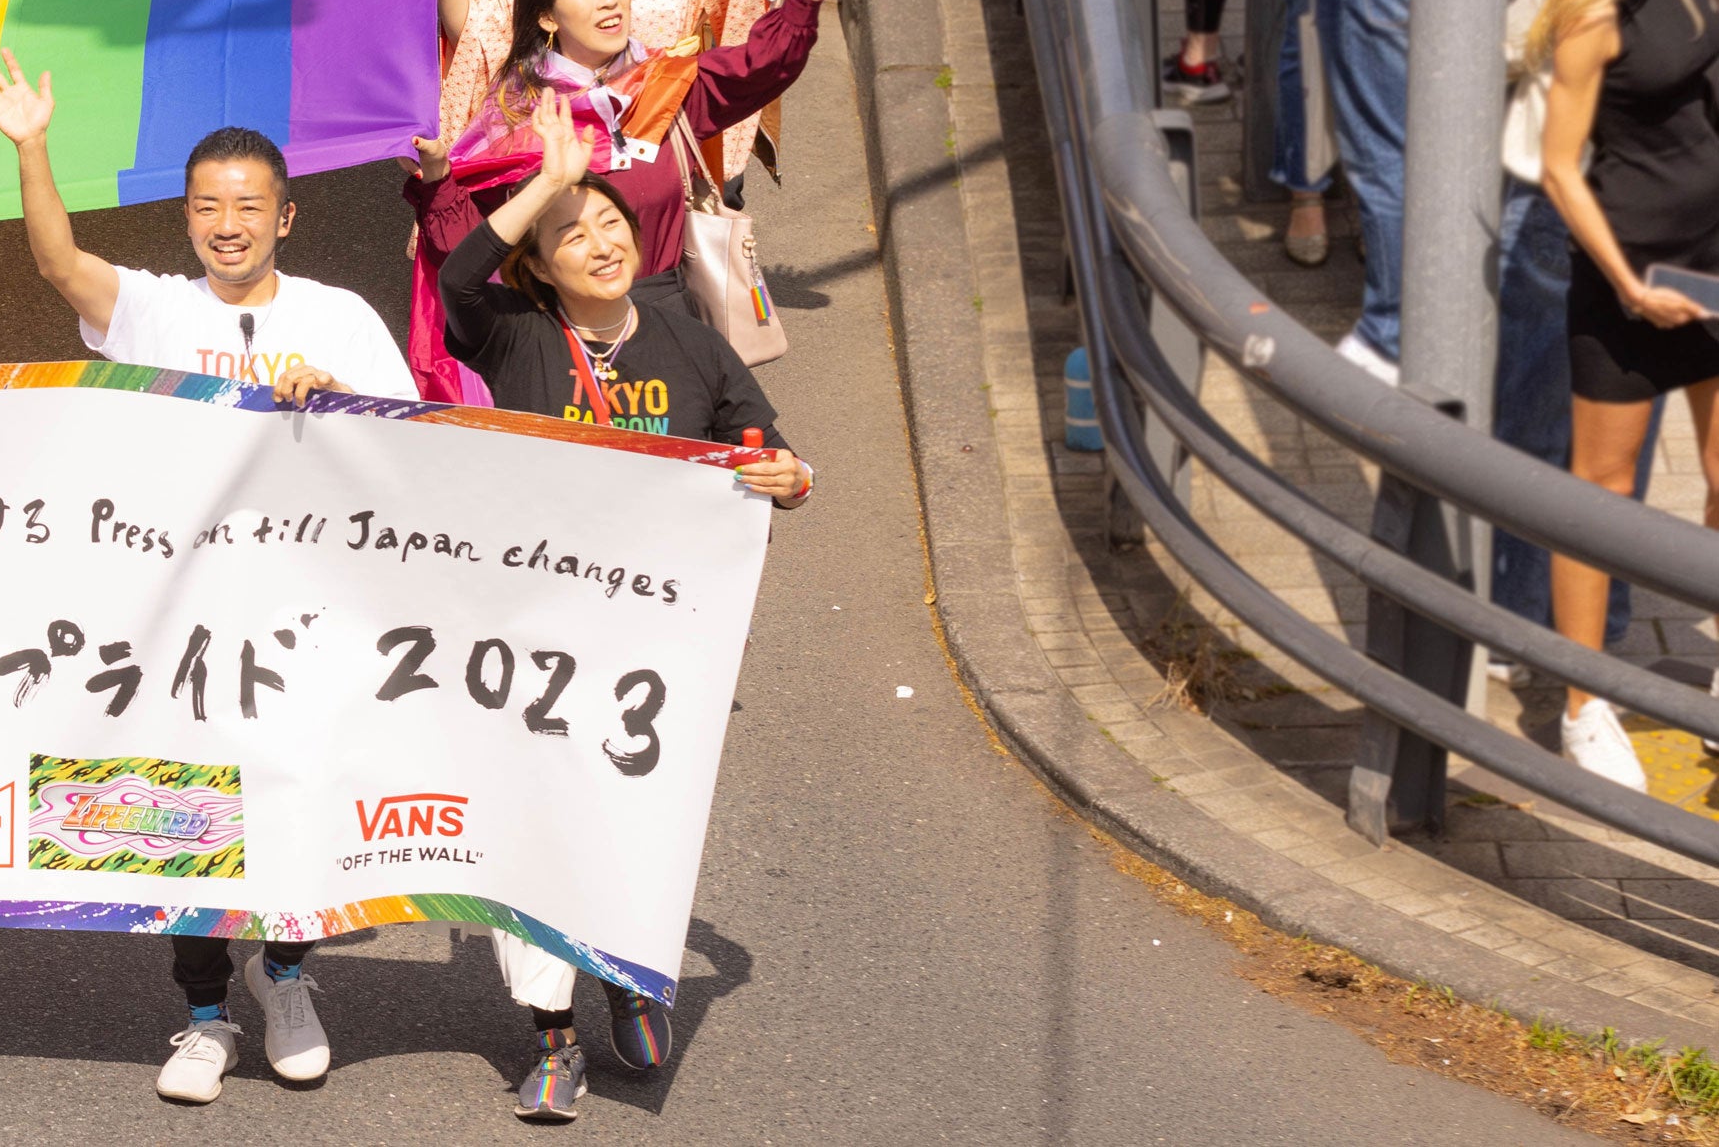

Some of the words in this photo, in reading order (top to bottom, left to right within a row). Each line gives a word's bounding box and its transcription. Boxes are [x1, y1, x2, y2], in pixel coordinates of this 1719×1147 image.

[569, 368, 669, 416] TKYO
[91, 499, 175, 559] Press
[193, 522, 234, 550] on
[253, 514, 327, 543] till
[347, 511, 483, 563] Japan
[375, 626, 667, 777] 2023
[355, 793, 469, 842] VANS
[378, 848, 413, 864] THE
